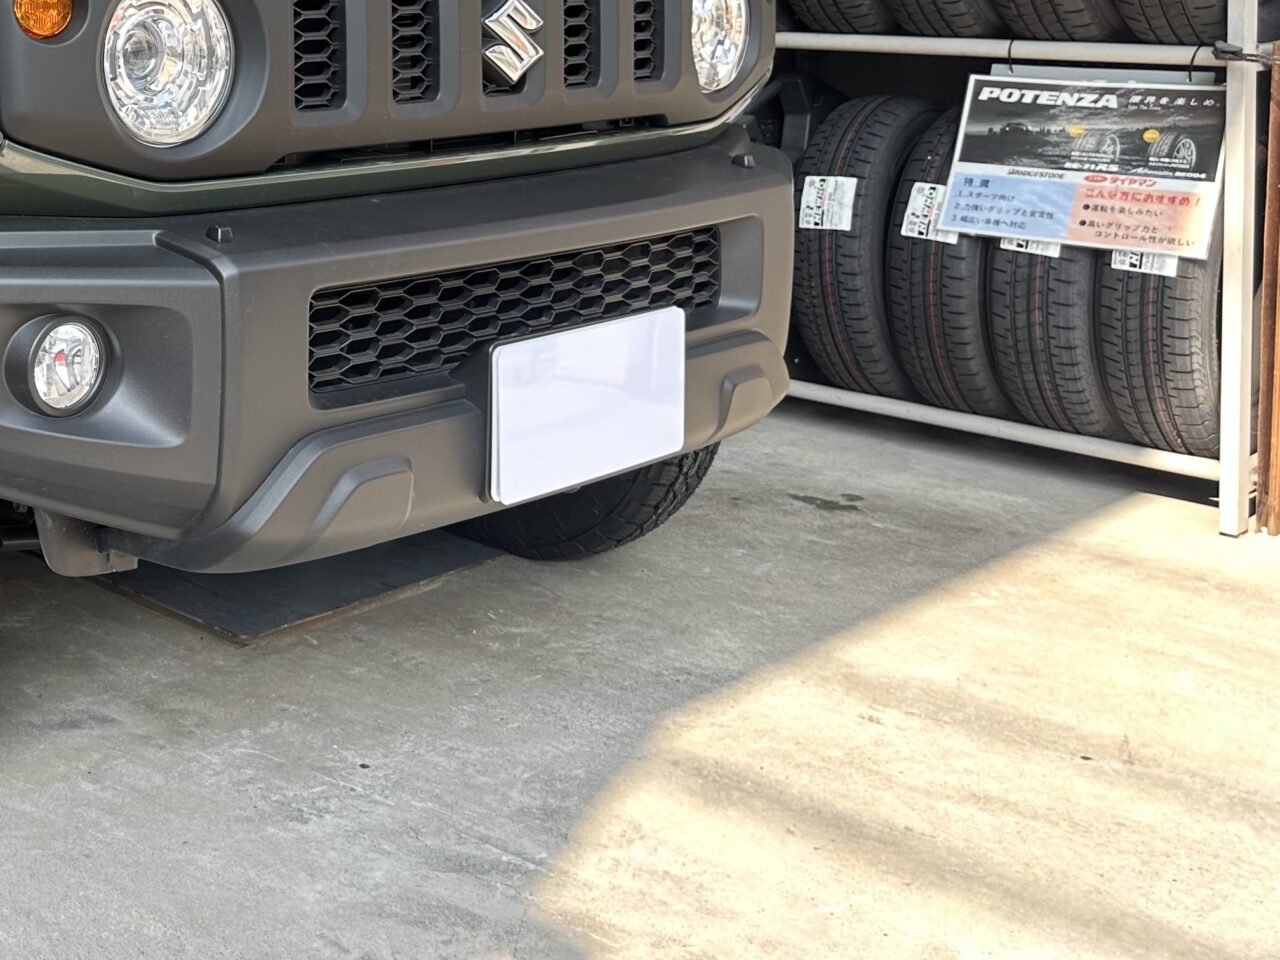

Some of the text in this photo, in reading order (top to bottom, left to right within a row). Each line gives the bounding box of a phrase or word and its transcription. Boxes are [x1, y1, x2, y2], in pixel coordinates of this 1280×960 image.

[978, 87, 1119, 109] POTENZA
[1007, 169, 1065, 180] BRIDGESTONE
[1109, 176, 1157, 188] タイヤマン
